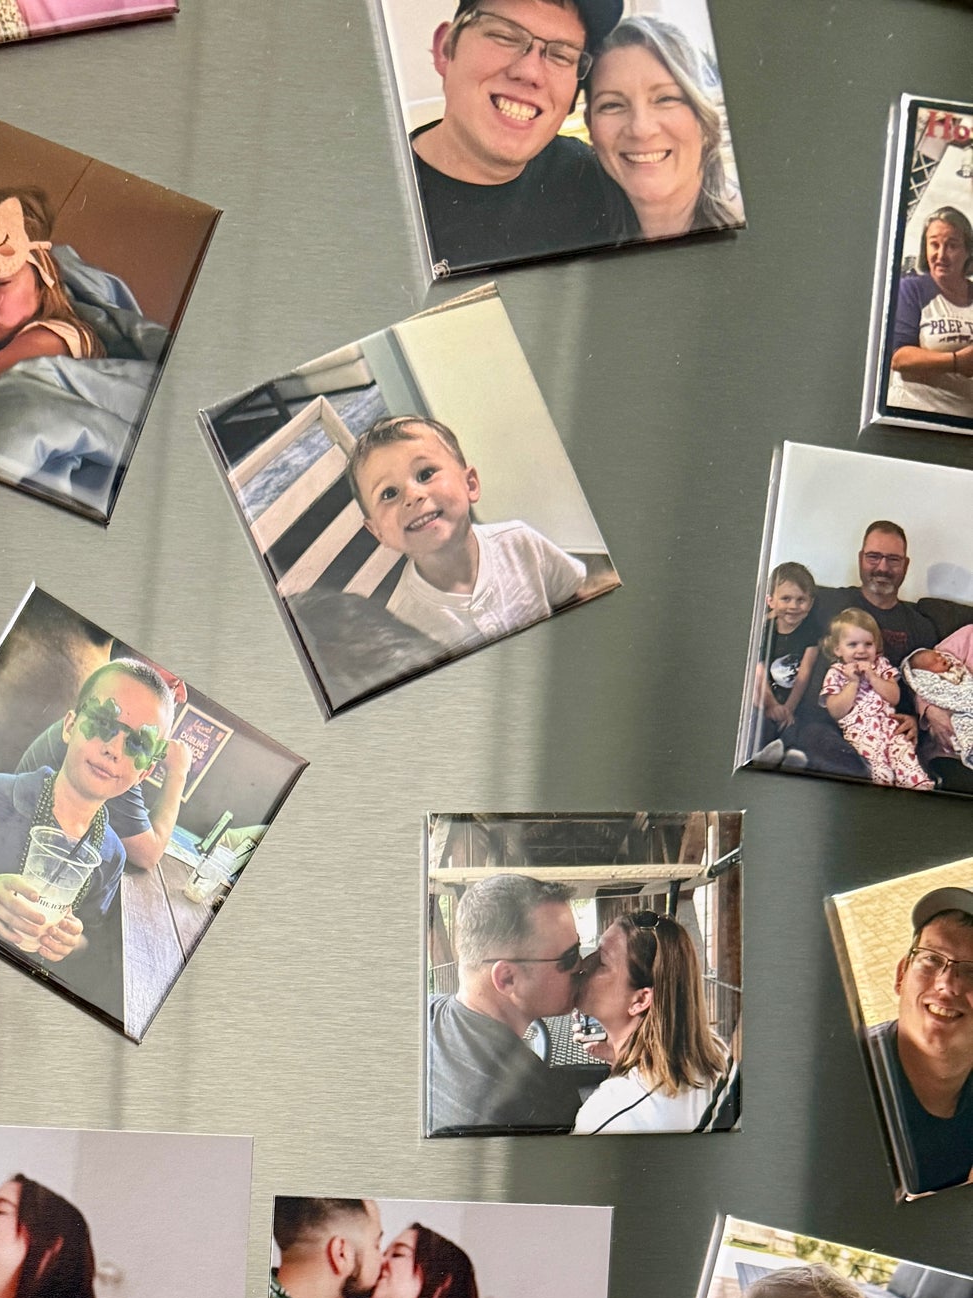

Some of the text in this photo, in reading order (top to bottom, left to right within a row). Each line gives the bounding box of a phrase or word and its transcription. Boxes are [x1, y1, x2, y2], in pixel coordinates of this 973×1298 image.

[925, 109, 973, 142] Ho
[930, 319, 962, 335] PREP
[180, 731, 208, 752] DUELING
